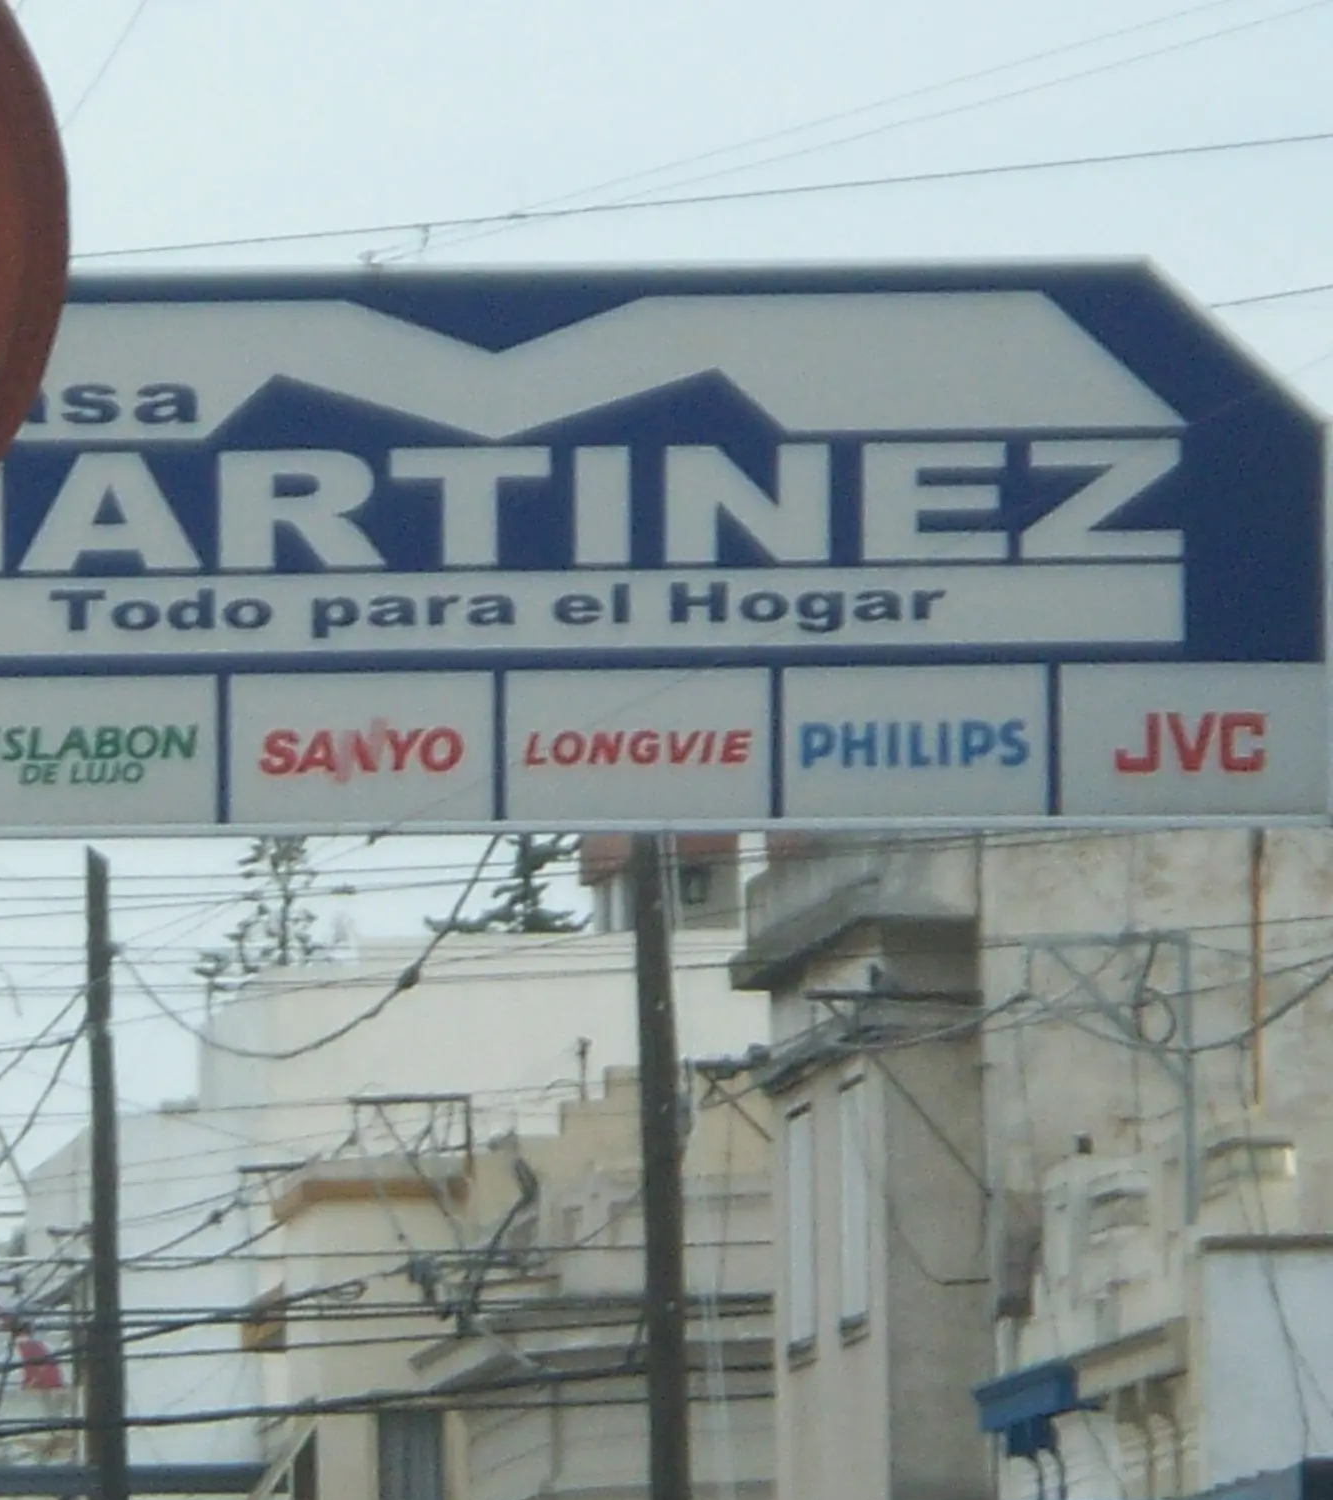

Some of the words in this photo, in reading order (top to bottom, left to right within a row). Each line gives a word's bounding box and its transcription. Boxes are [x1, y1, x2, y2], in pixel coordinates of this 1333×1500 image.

[49, 588, 274, 634] Todo
[311, 588, 517, 638] para
[552, 583, 630, 626] el
[668, 581, 948, 632] Hogar
[259, 718, 465, 784] SANYO
[524, 729, 754, 767] LONGVIE
[799, 718, 1032, 769] PHILIPS
[1114, 711, 1269, 776] JVC
[18, 760, 62, 786] DE
[69, 758, 146, 786] LUJO
